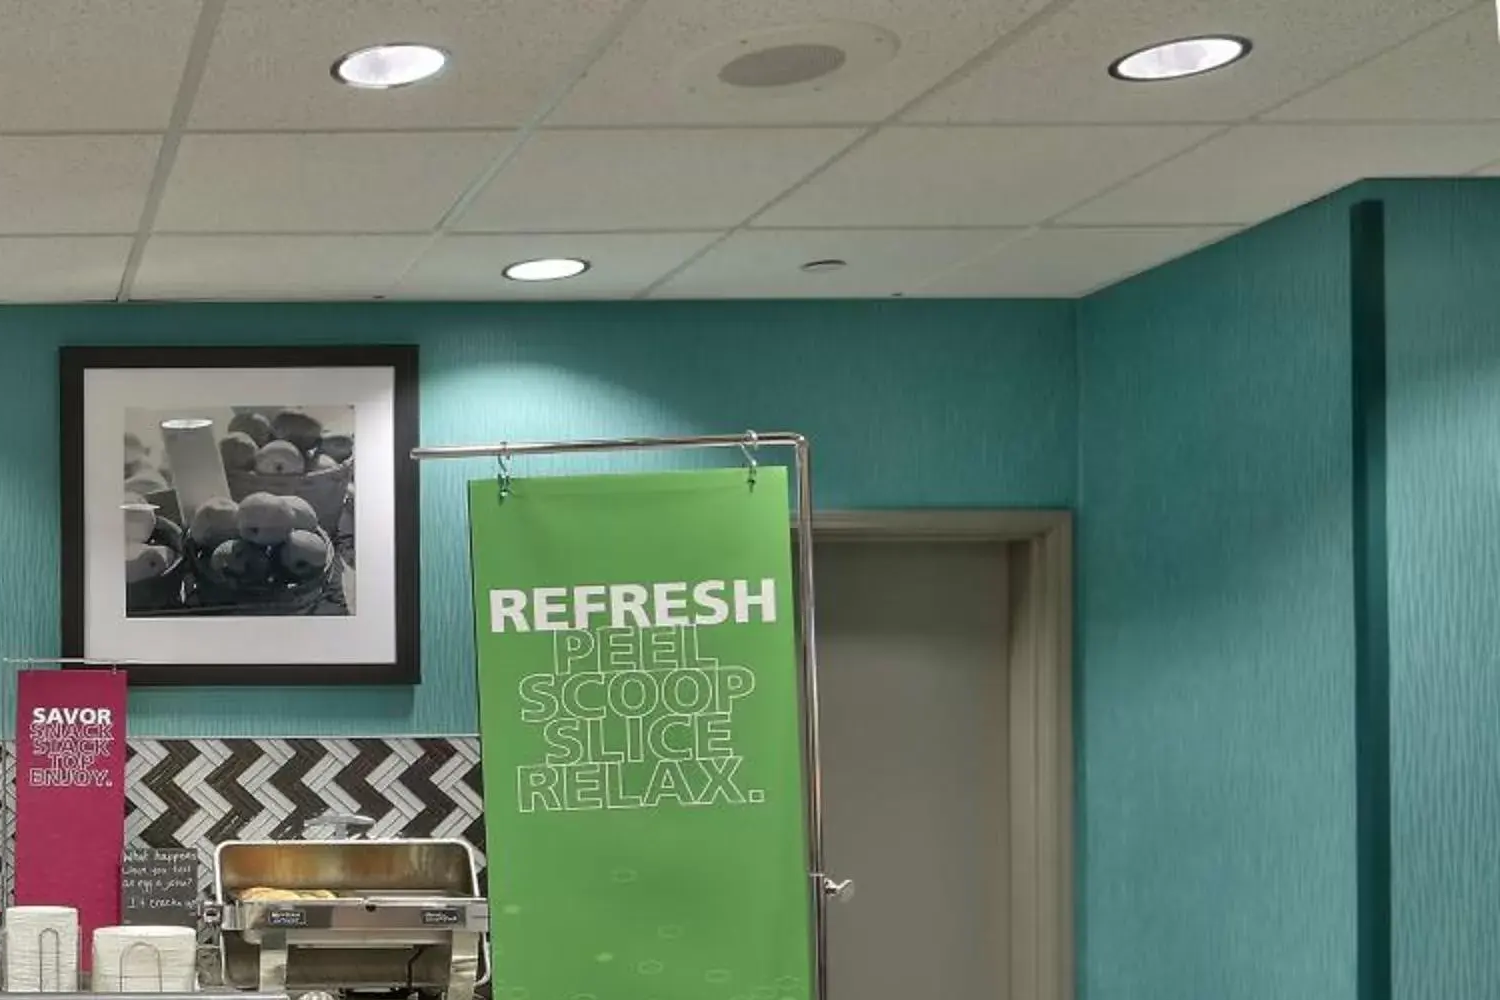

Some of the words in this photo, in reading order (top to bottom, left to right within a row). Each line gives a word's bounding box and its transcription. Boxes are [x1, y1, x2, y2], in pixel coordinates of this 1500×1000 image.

[489, 578, 777, 633] REFRESH
[553, 624, 719, 676] PEEL
[32, 707, 111, 724] SAVOR
[518, 665, 756, 722] SCOOP
[29, 723, 114, 740] SNACK
[32, 738, 111, 755] STACK
[543, 712, 734, 766] SLICE
[48, 752, 95, 770] TOP
[516, 756, 765, 813] RELAX.
